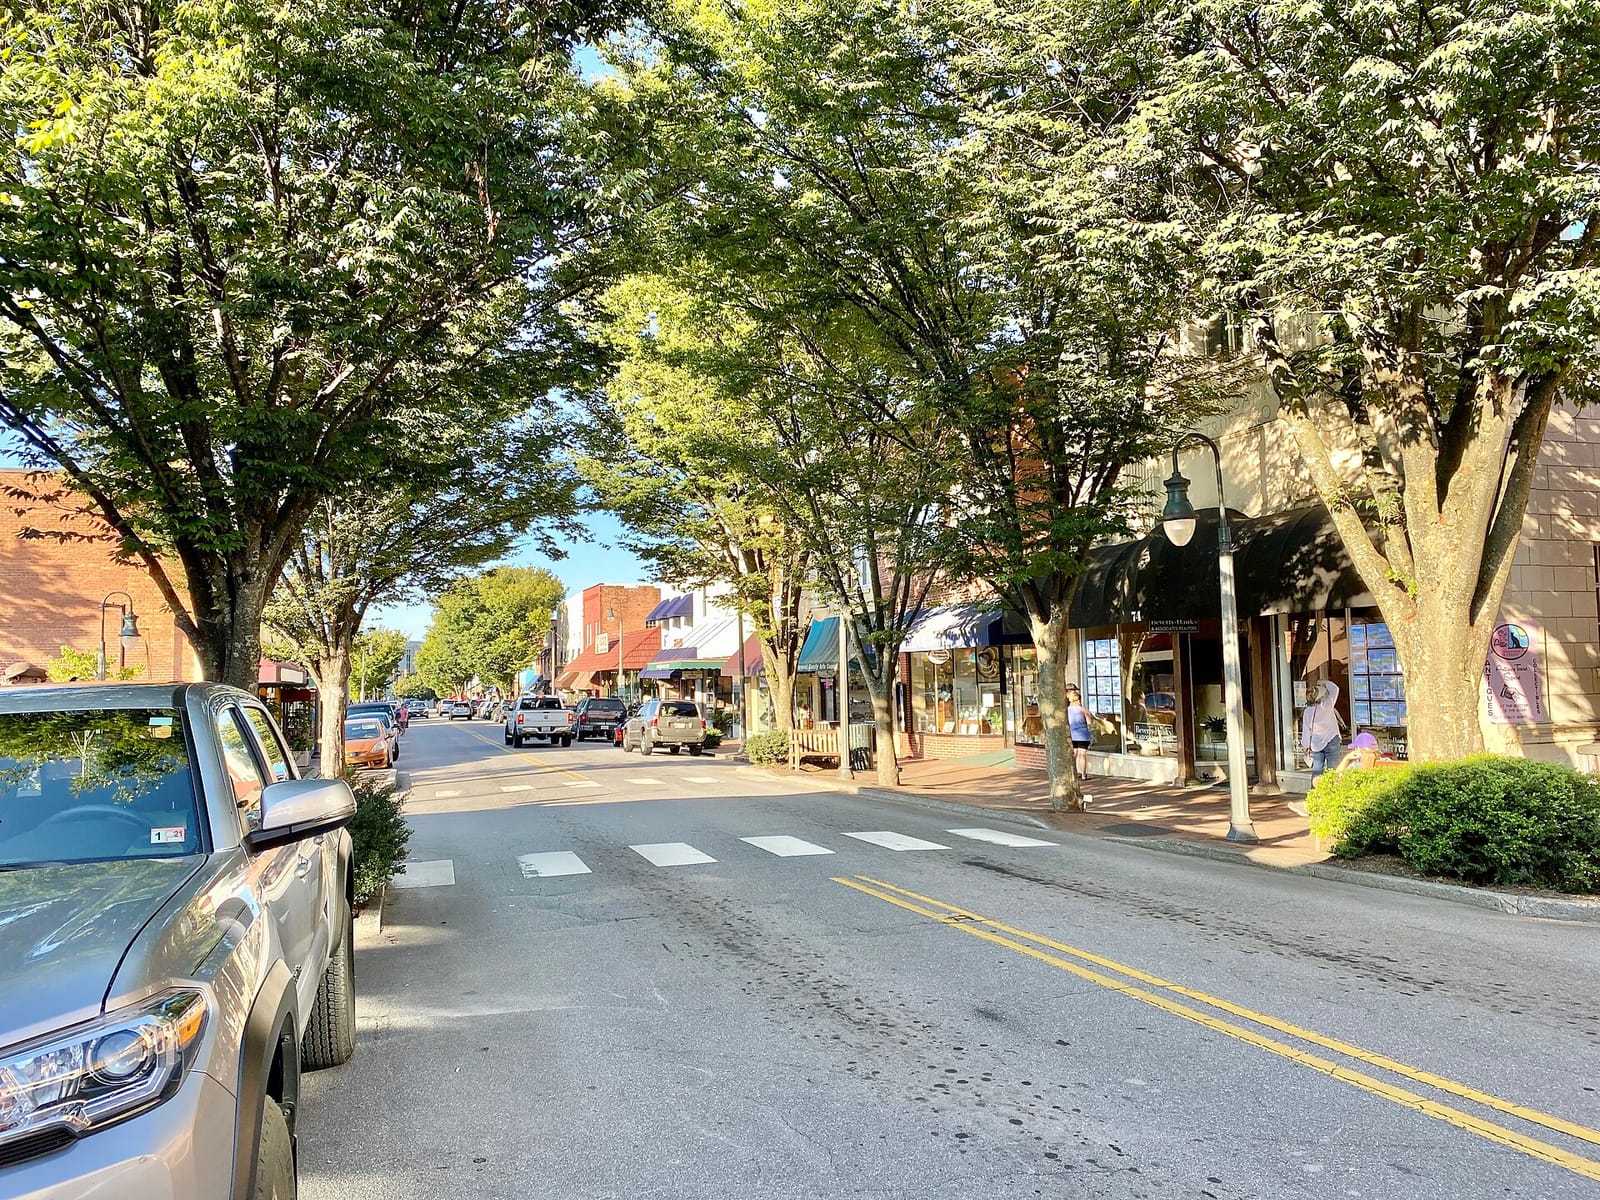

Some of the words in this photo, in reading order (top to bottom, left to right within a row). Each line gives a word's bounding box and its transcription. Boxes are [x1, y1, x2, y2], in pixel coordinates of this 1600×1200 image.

[1130, 610, 1142, 622] 74
[1485, 660, 1493, 716] ANTIQUES
[155, 831, 161, 841] 1
